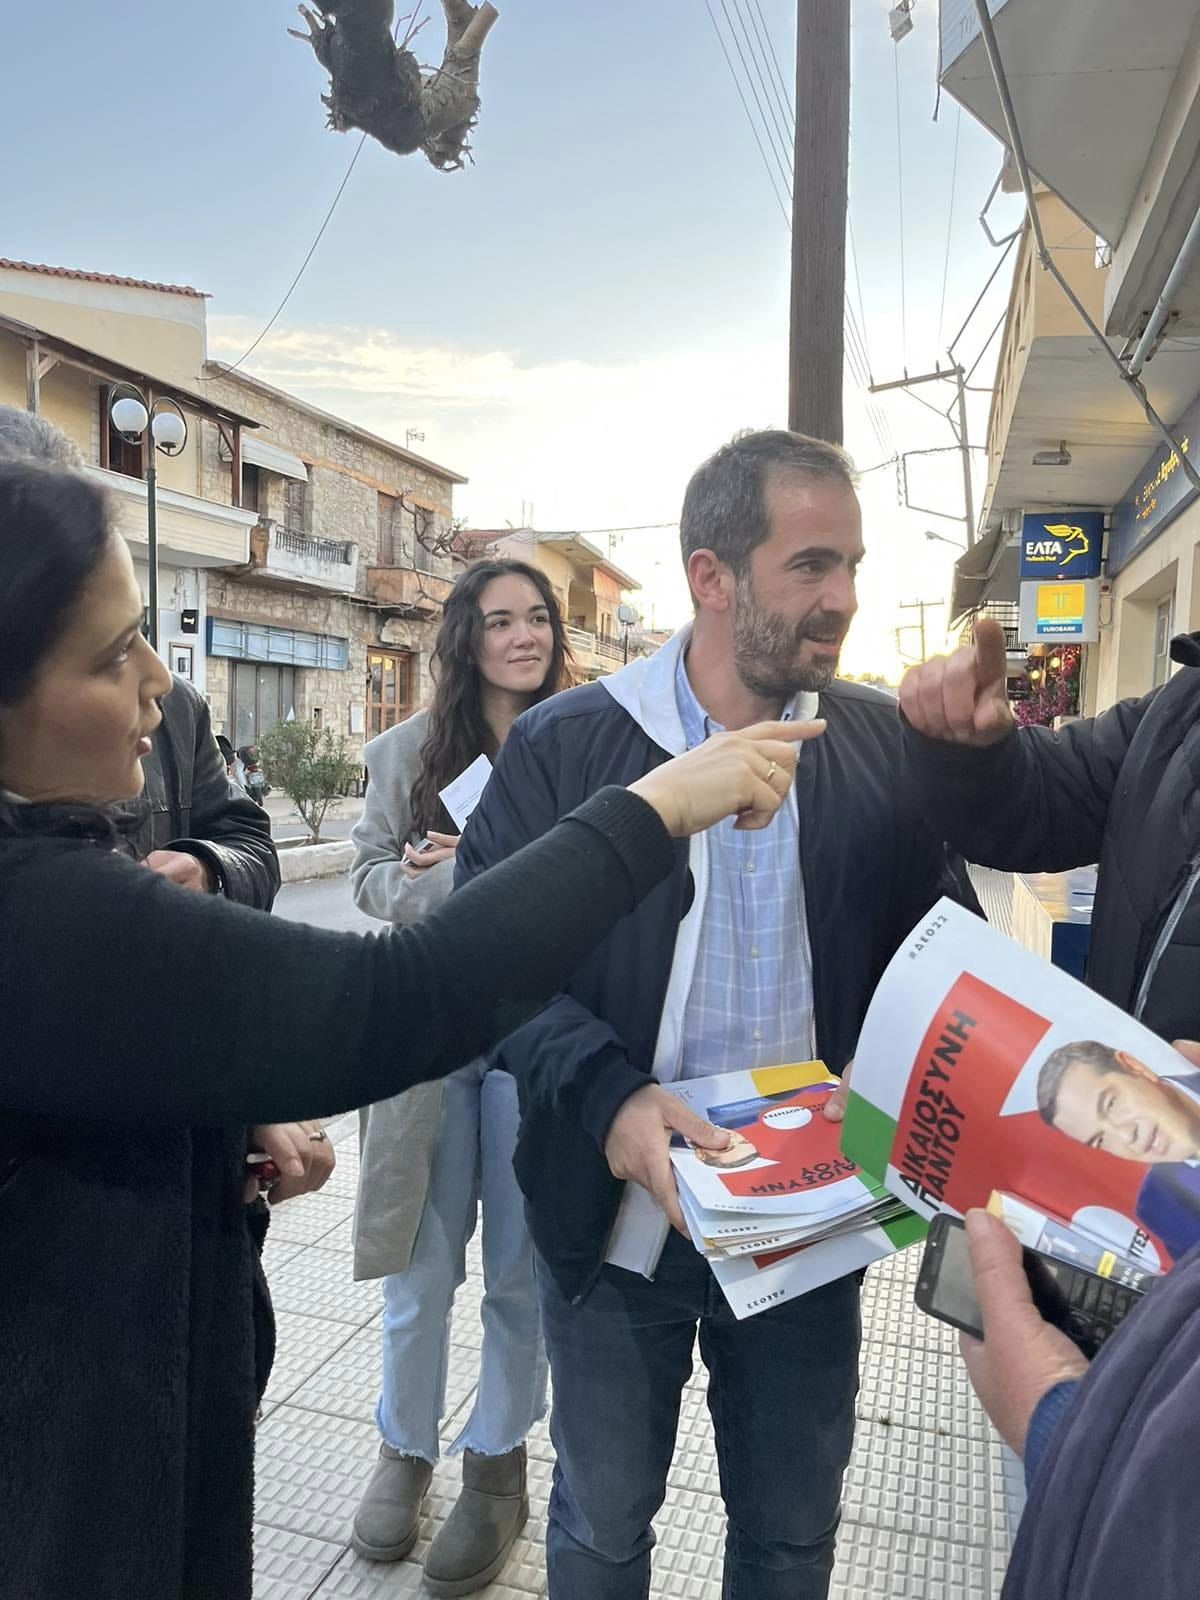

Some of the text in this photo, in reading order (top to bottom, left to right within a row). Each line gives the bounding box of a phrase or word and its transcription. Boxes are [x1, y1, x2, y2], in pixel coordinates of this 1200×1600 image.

[1026, 541, 1063, 555] ΕΛΤΑ
[899, 1008, 978, 1198] ΔΙΚΑΙΟΣΥΝΗ
[750, 1161, 856, 1193] ΑΙΟΣΥΝΗ
[918, 1095, 966, 1212] ΠΑΝΤΟΥ
